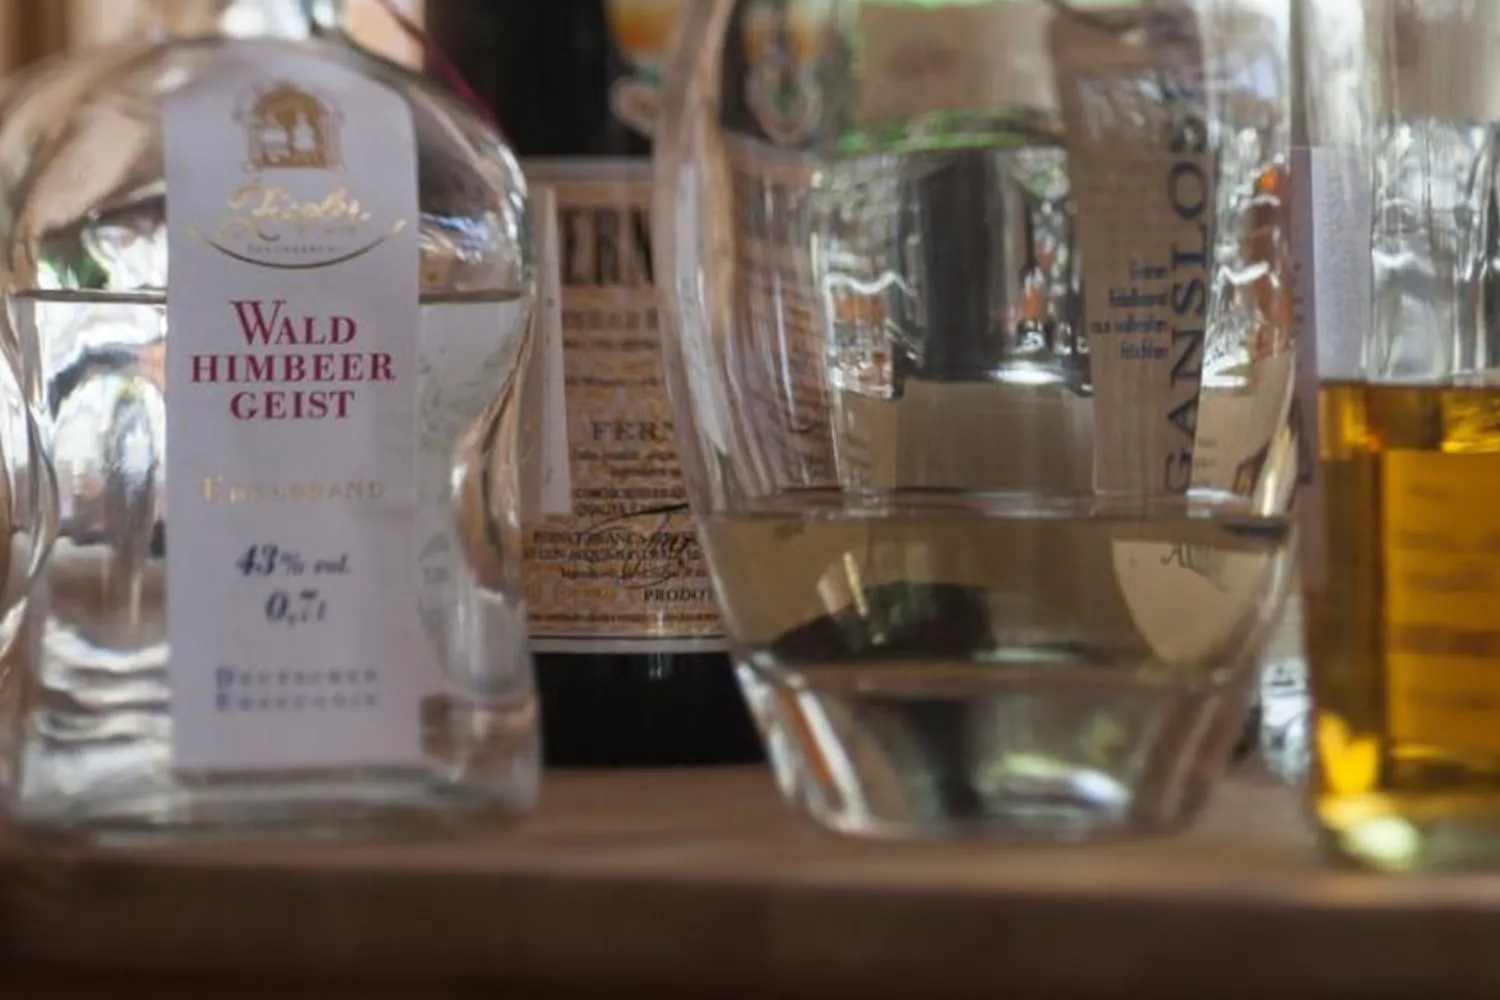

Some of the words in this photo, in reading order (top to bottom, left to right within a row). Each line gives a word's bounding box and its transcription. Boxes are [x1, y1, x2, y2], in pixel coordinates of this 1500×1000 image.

[230, 300, 357, 346] WALD
[190, 352, 396, 384] HIMBEER
[229, 390, 356, 420] GEIST
